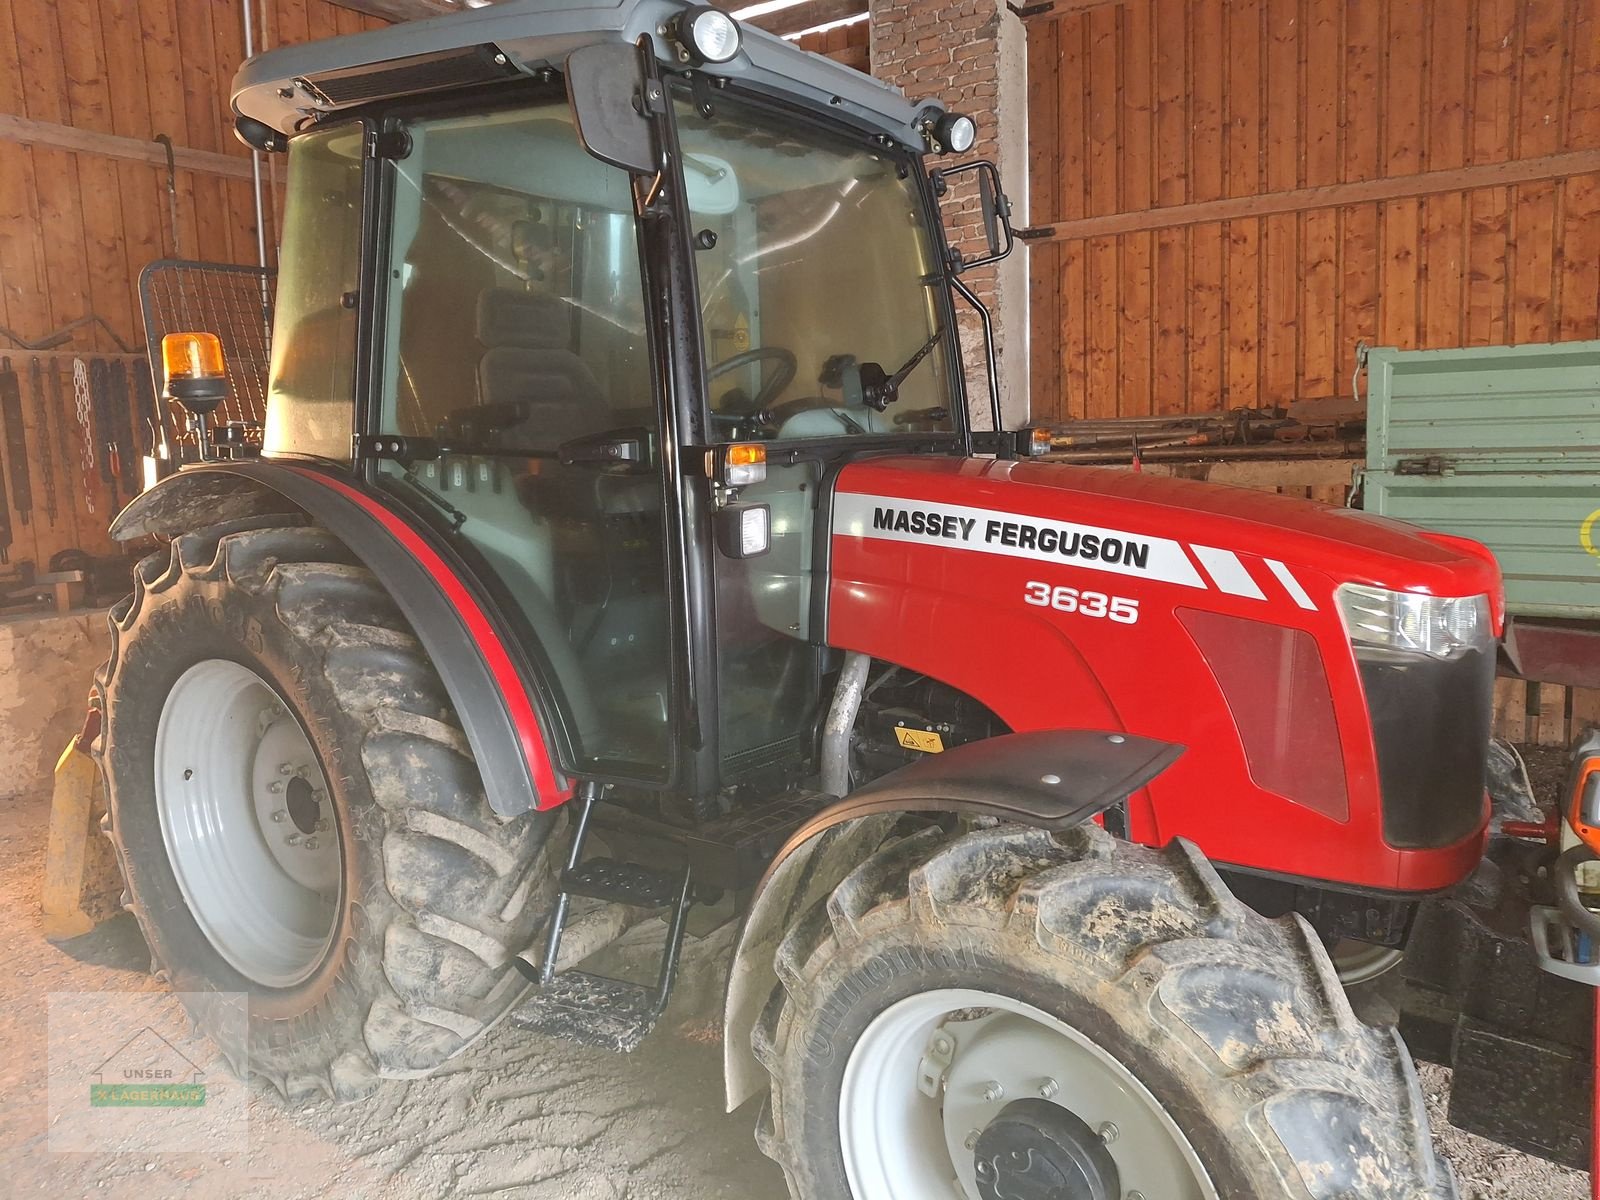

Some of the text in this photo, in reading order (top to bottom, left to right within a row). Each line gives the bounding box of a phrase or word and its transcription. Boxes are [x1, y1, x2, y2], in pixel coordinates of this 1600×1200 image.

[873, 507, 1150, 569] MASSEY FERGUSON
[1023, 580, 1140, 626] 3635
